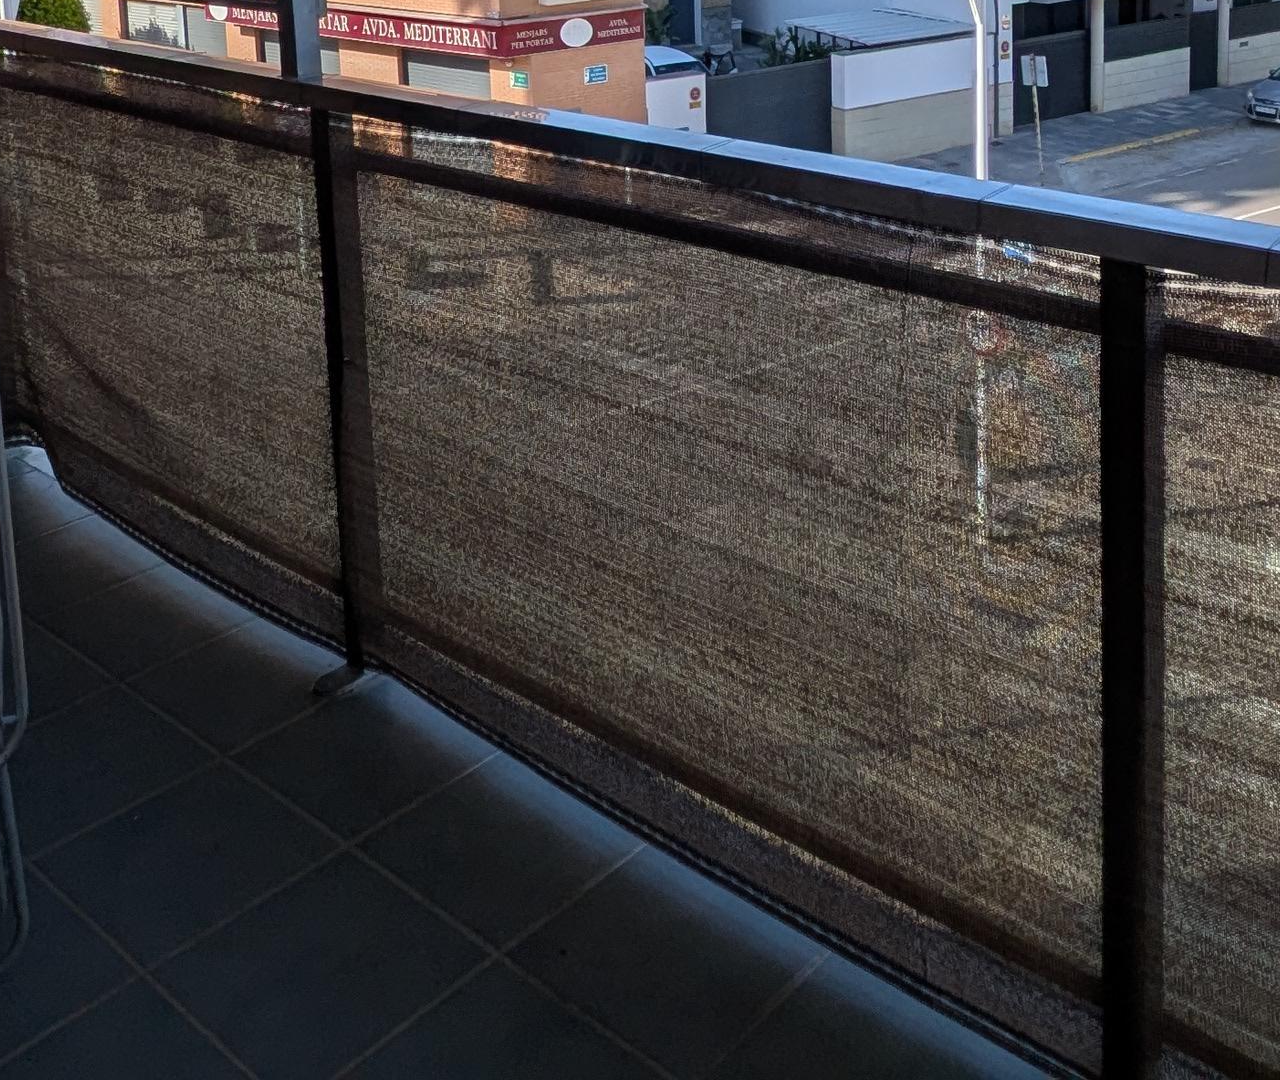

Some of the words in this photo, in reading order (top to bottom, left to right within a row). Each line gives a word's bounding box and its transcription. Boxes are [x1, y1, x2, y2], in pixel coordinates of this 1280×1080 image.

[362, 18, 400, 38] AVDA.
[403, 22, 498, 50] MEDITERRANI
[516, 28, 548, 39] MENJARS
[597, 25, 641, 38] MEDITERRANI
[511, 41, 524, 50] PER
[525, 38, 554, 48] PORTAR
